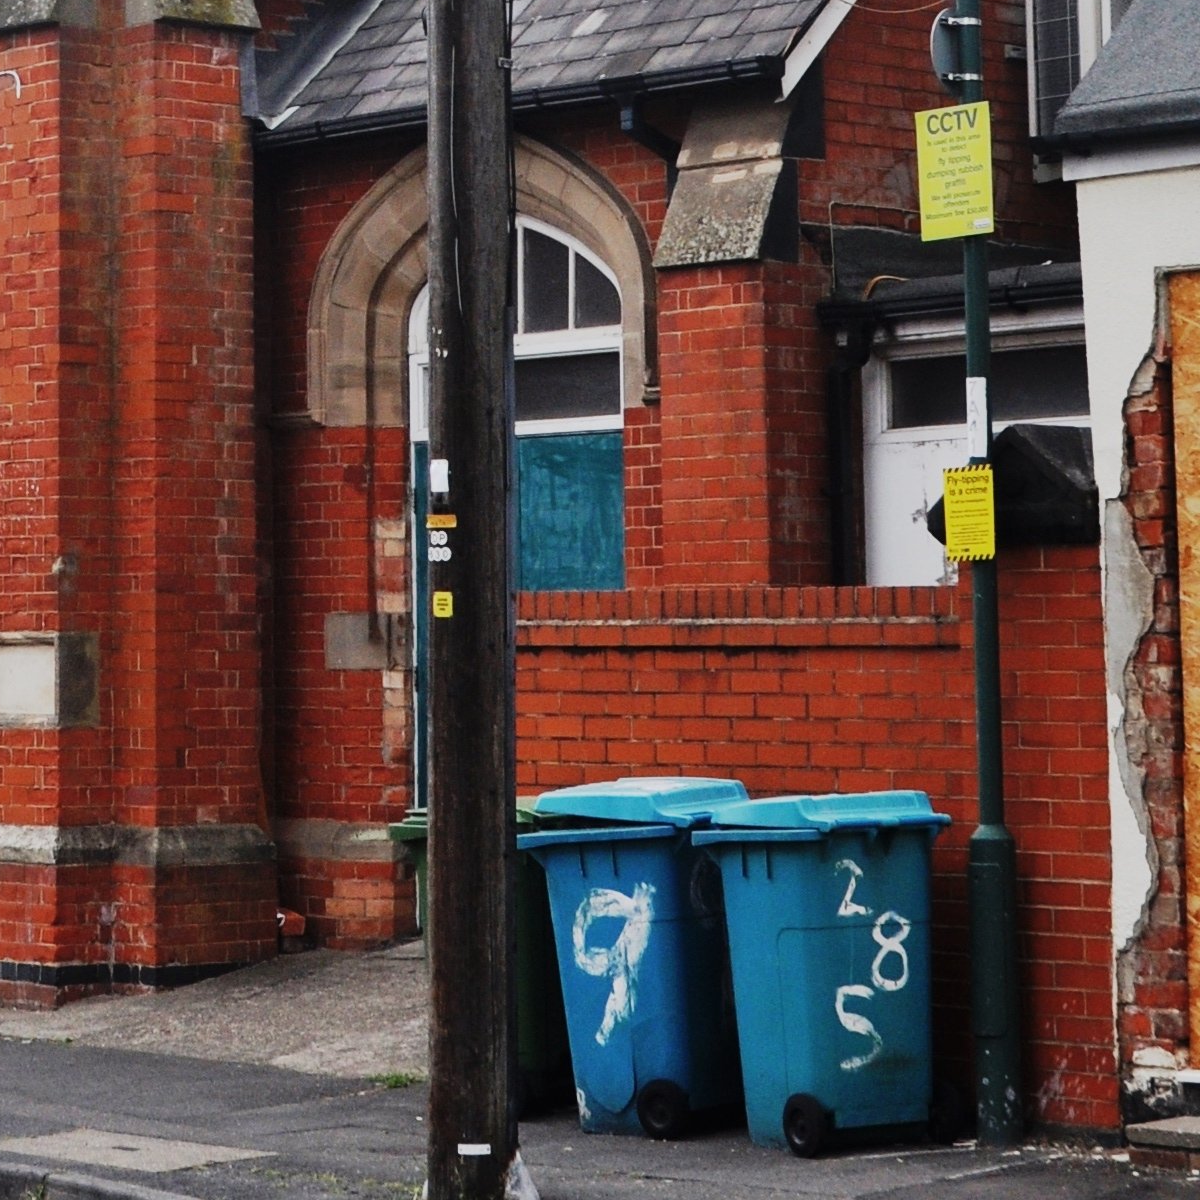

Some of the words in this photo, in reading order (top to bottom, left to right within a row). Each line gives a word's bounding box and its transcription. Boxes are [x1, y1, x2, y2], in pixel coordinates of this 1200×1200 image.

[926, 108, 978, 135] CCTV
[949, 144, 967, 152] detect
[948, 154, 971, 164] tipping
[926, 168, 957, 179] dumping
[958, 164, 983, 174] rubbish
[947, 474, 990, 486] Fly-tipping
[949, 488, 956, 496] is
[965, 487, 988, 495] crime
